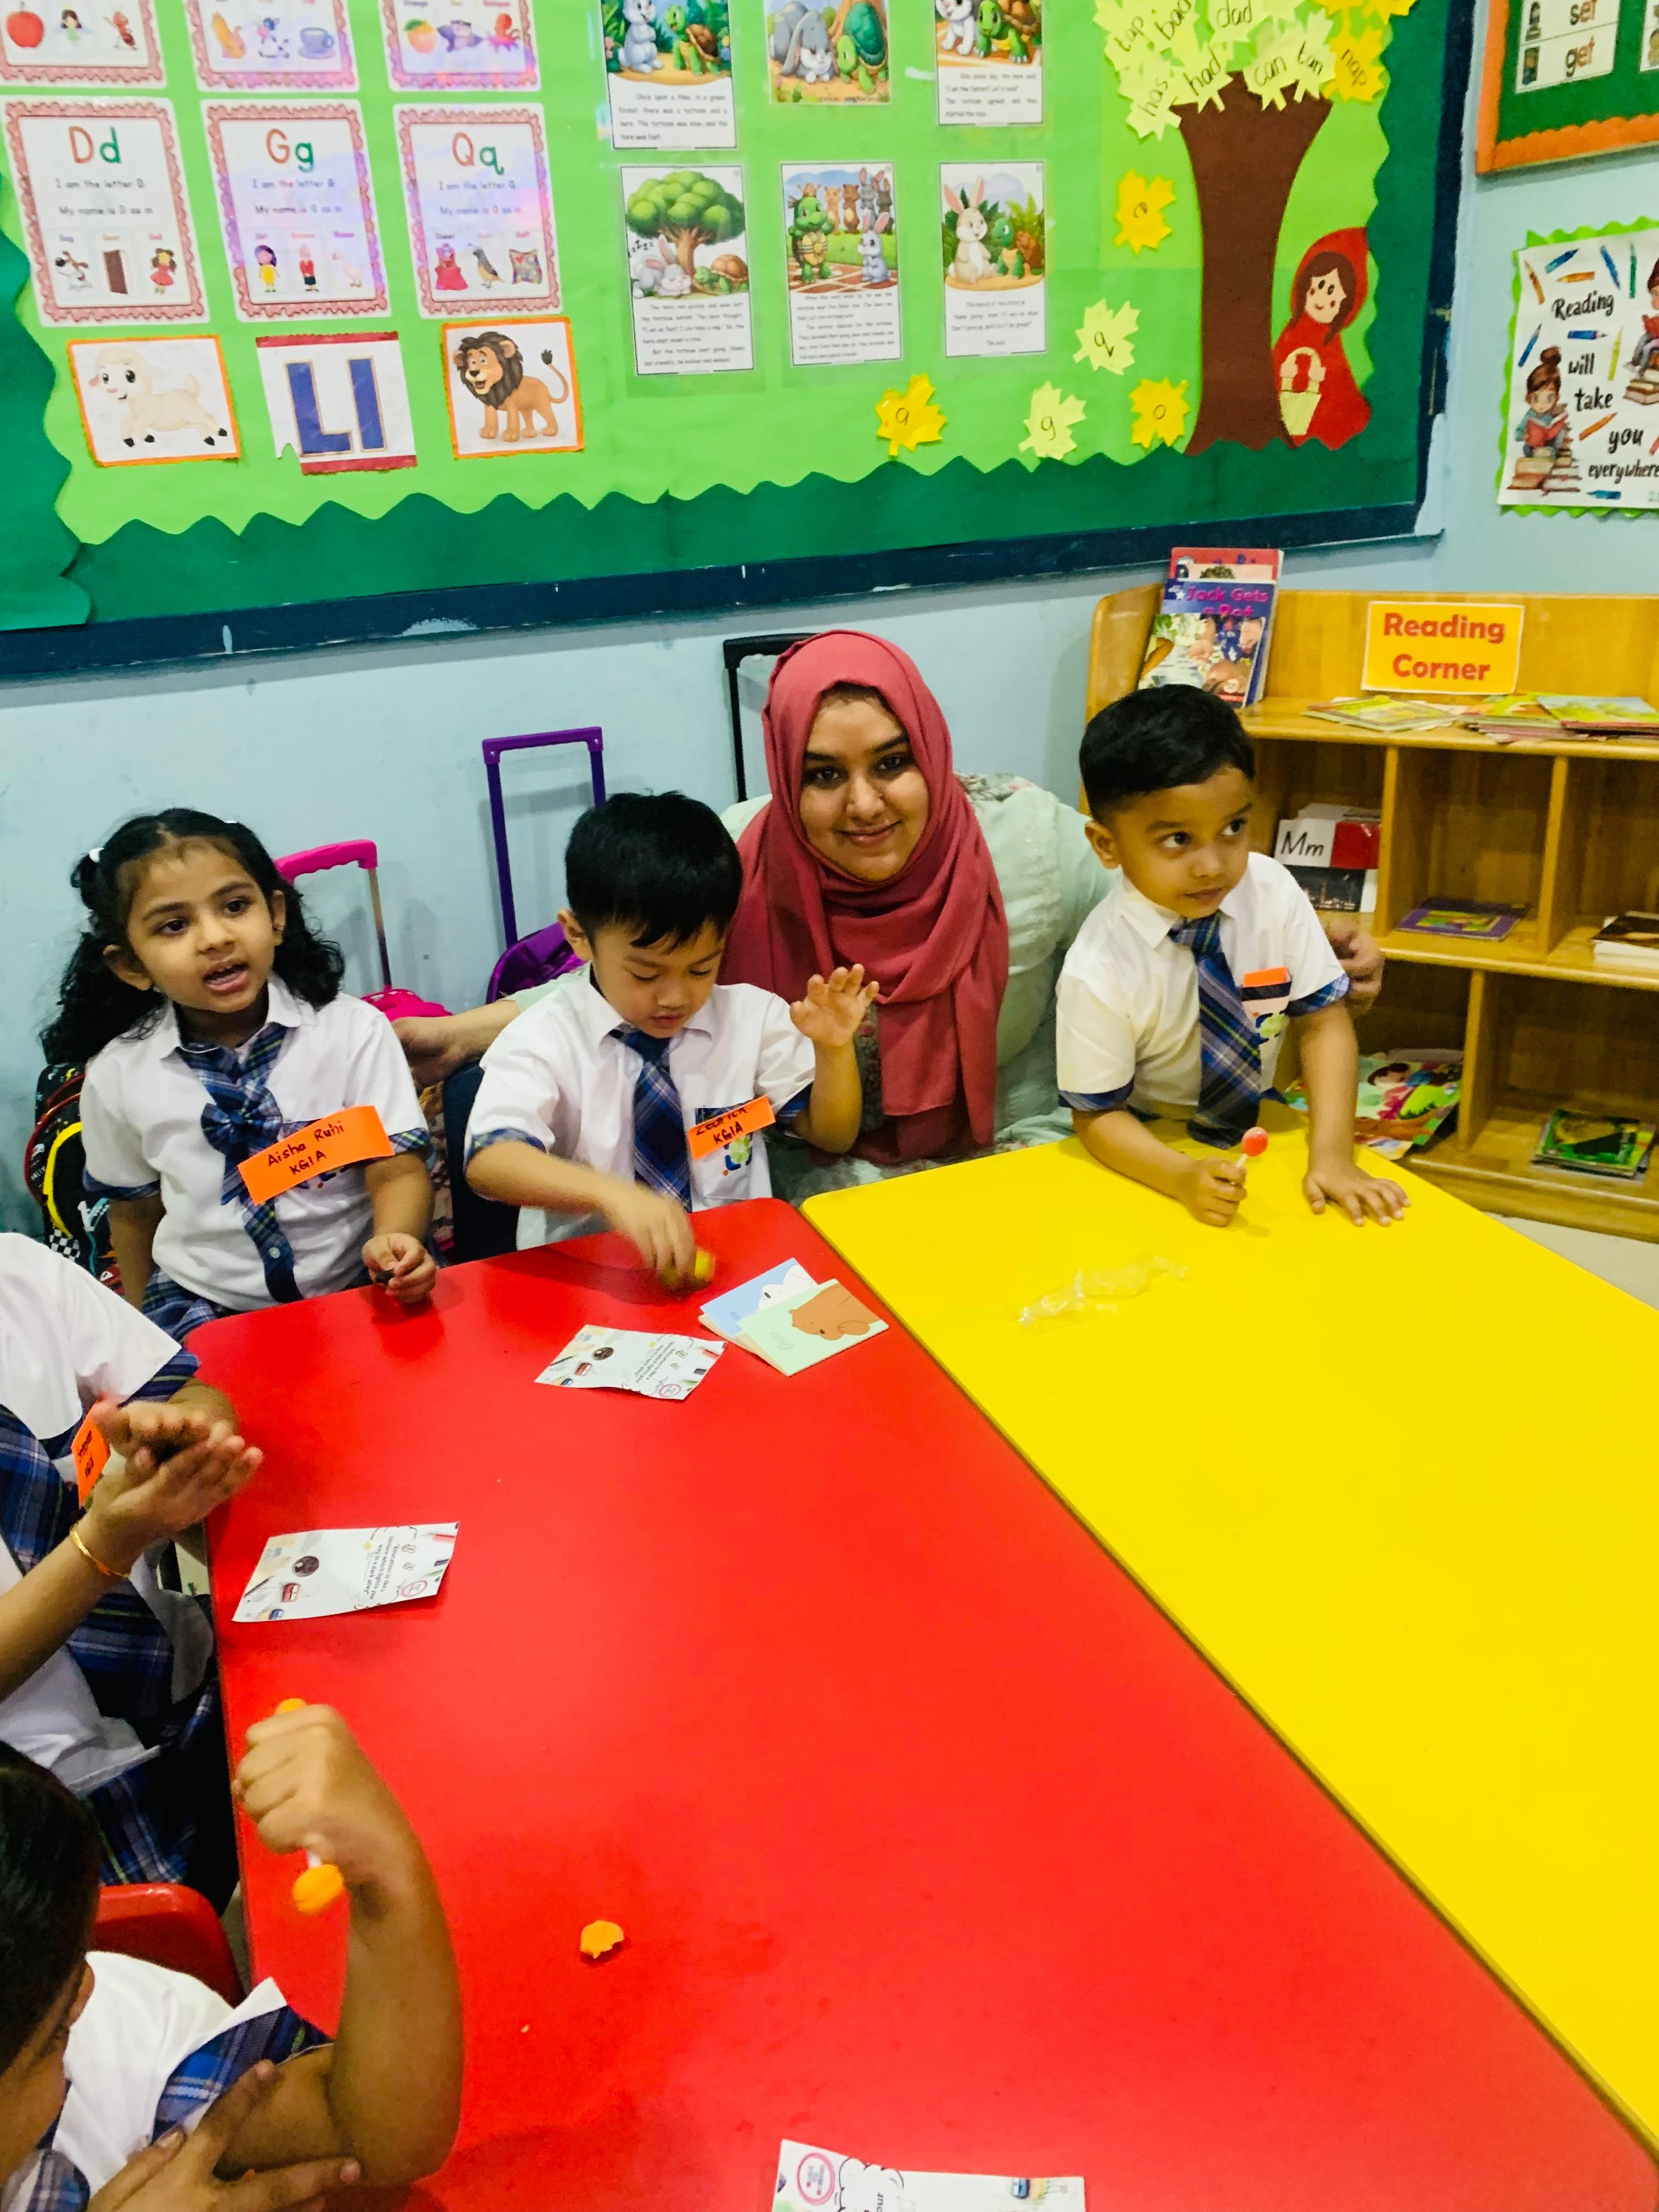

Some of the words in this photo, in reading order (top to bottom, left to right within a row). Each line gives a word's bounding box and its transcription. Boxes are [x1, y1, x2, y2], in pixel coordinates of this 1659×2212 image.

[1182, 45, 1221, 96] had
[1255, 56, 1286, 87] can
[1341, 48, 1368, 86] nap
[1566, 35, 1595, 77] get
[1137, 77, 1168, 117] has
[69, 126, 121, 163] Dd
[266, 128, 314, 173] Gg
[453, 132, 505, 176] Qq
[1551, 290, 1615, 320] Reading
[1568, 353, 1595, 375] will
[1575, 387, 1613, 412] take
[1609, 427, 1644, 454] you
[1187, 586, 1225, 601] Jack
[1231, 588, 1268, 602] Gets
[1384, 612, 1505, 644] Reading
[1392, 653, 1490, 681] Corner
[1280, 831, 1324, 856] Mm
[268, 1142, 306, 1167] Aisha
